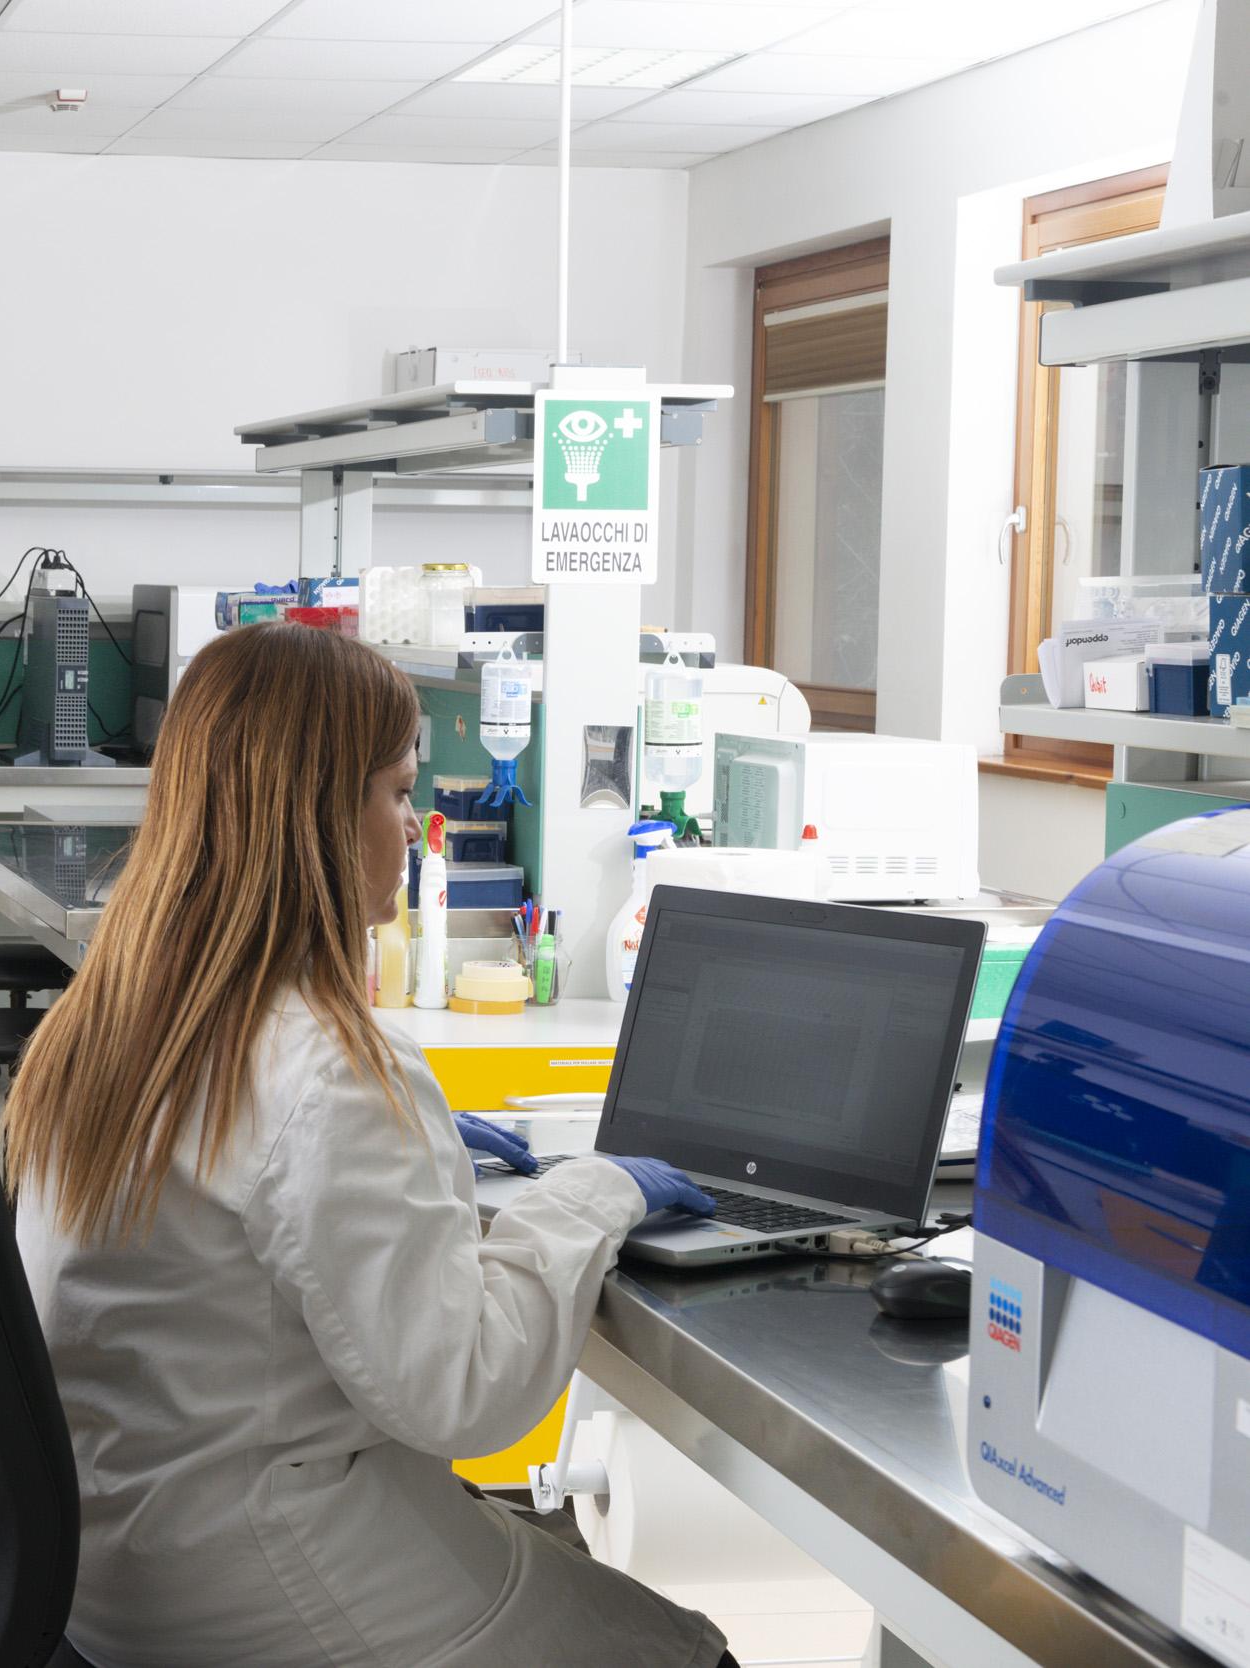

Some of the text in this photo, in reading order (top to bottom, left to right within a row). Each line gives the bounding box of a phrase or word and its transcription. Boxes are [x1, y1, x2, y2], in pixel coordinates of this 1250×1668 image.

[541, 521, 648, 543] LAVAOCCHI DI
[546, 551, 642, 572] EMERGENZA
[1231, 598, 1250, 637] QIAGEN
[1065, 633, 1109, 647] eppendorf
[988, 1323, 1020, 1352] QIAGEN
[1019, 1464, 1065, 1506] Advanced
